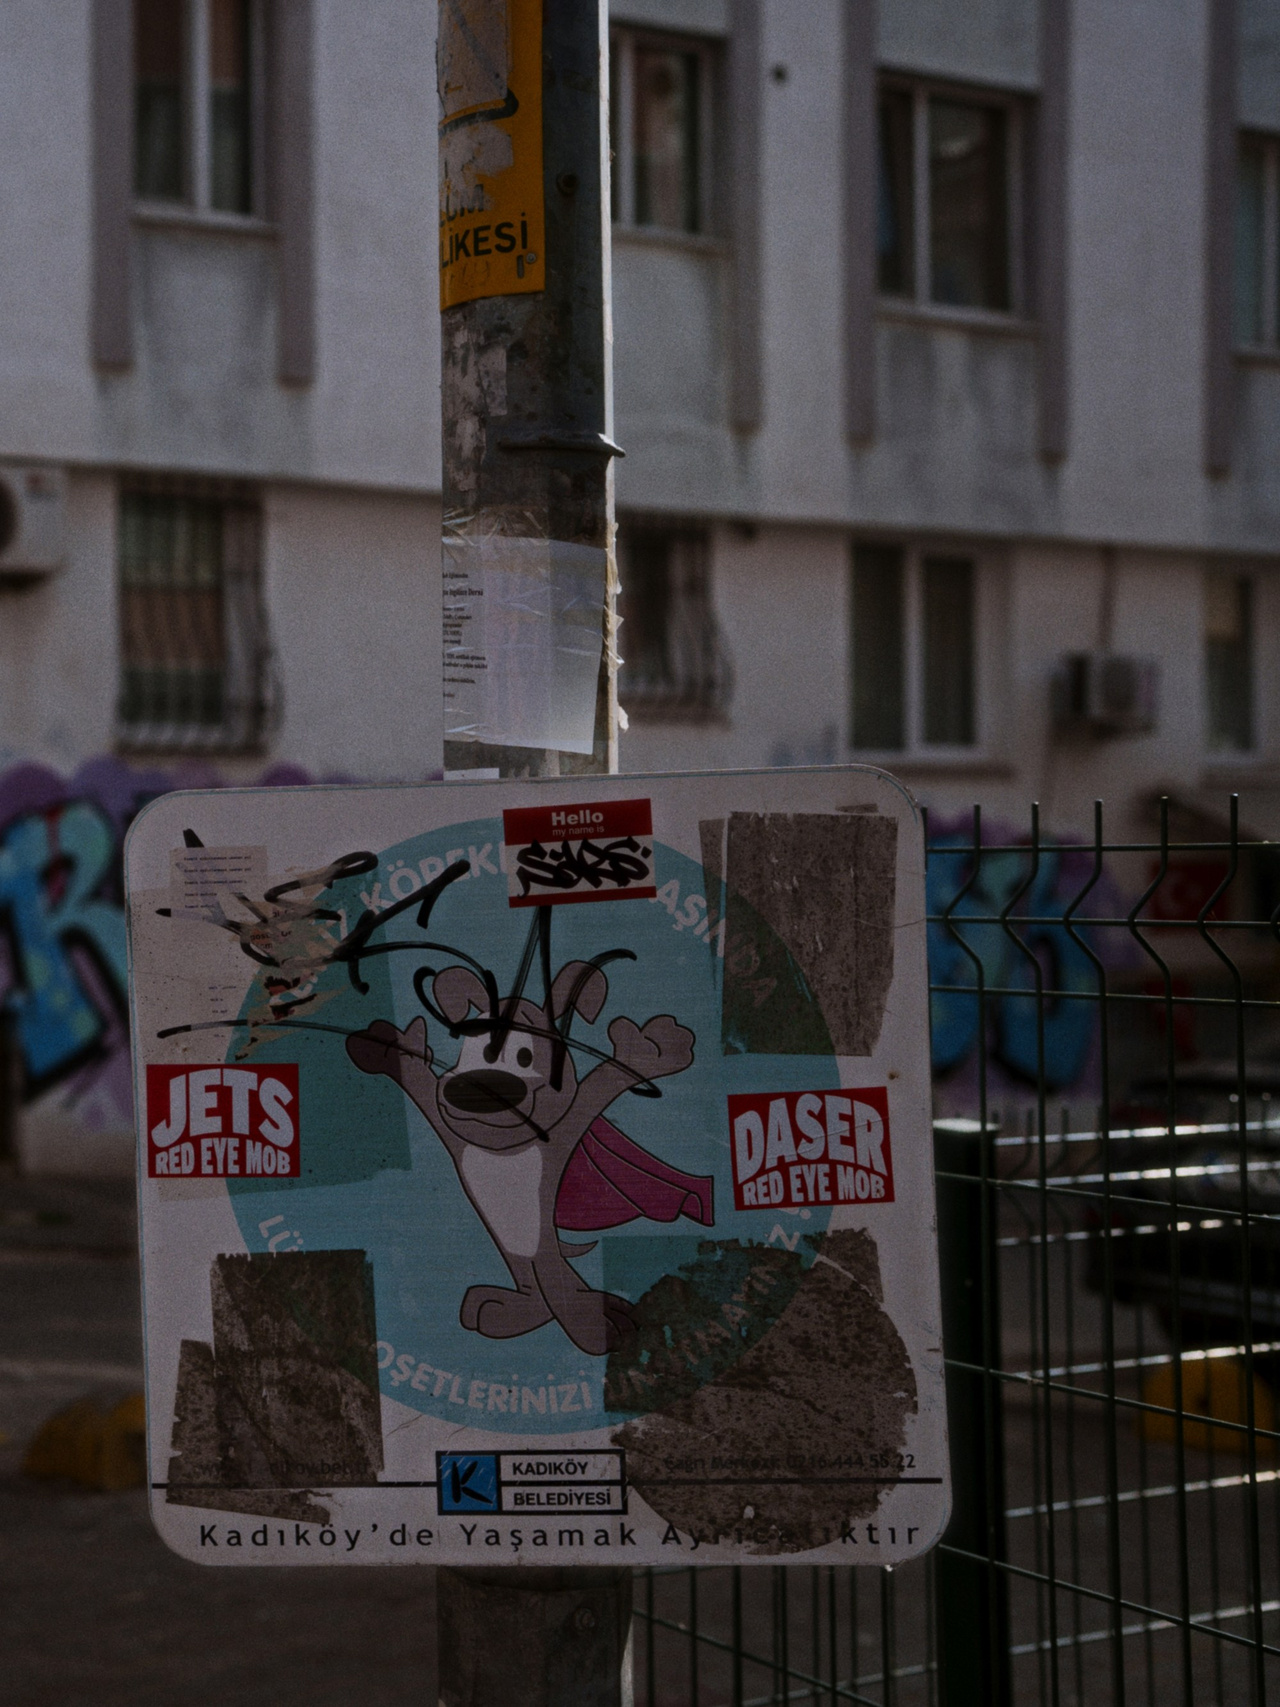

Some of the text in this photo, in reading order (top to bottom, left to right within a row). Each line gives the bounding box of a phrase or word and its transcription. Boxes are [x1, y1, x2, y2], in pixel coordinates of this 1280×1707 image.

[551, 809, 604, 827] Hello
[552, 824, 605, 838] my name is
[648, 878, 778, 1008] AŞINDA
[151, 1068, 294, 1148] JETS
[733, 1092, 889, 1185] DASER
[155, 1137, 291, 1174] RED EYE MOB
[742, 1163, 885, 1206] RED EYE MOB
[368, 1340, 594, 1415] OŞETLERİNİZİ
[513, 1458, 588, 1476] KADIKÖY
[895, 1454, 916, 1469] 22
[514, 1489, 611, 1506] BELEDİYESİ
[460, 1522, 637, 1552] Yaşamak
